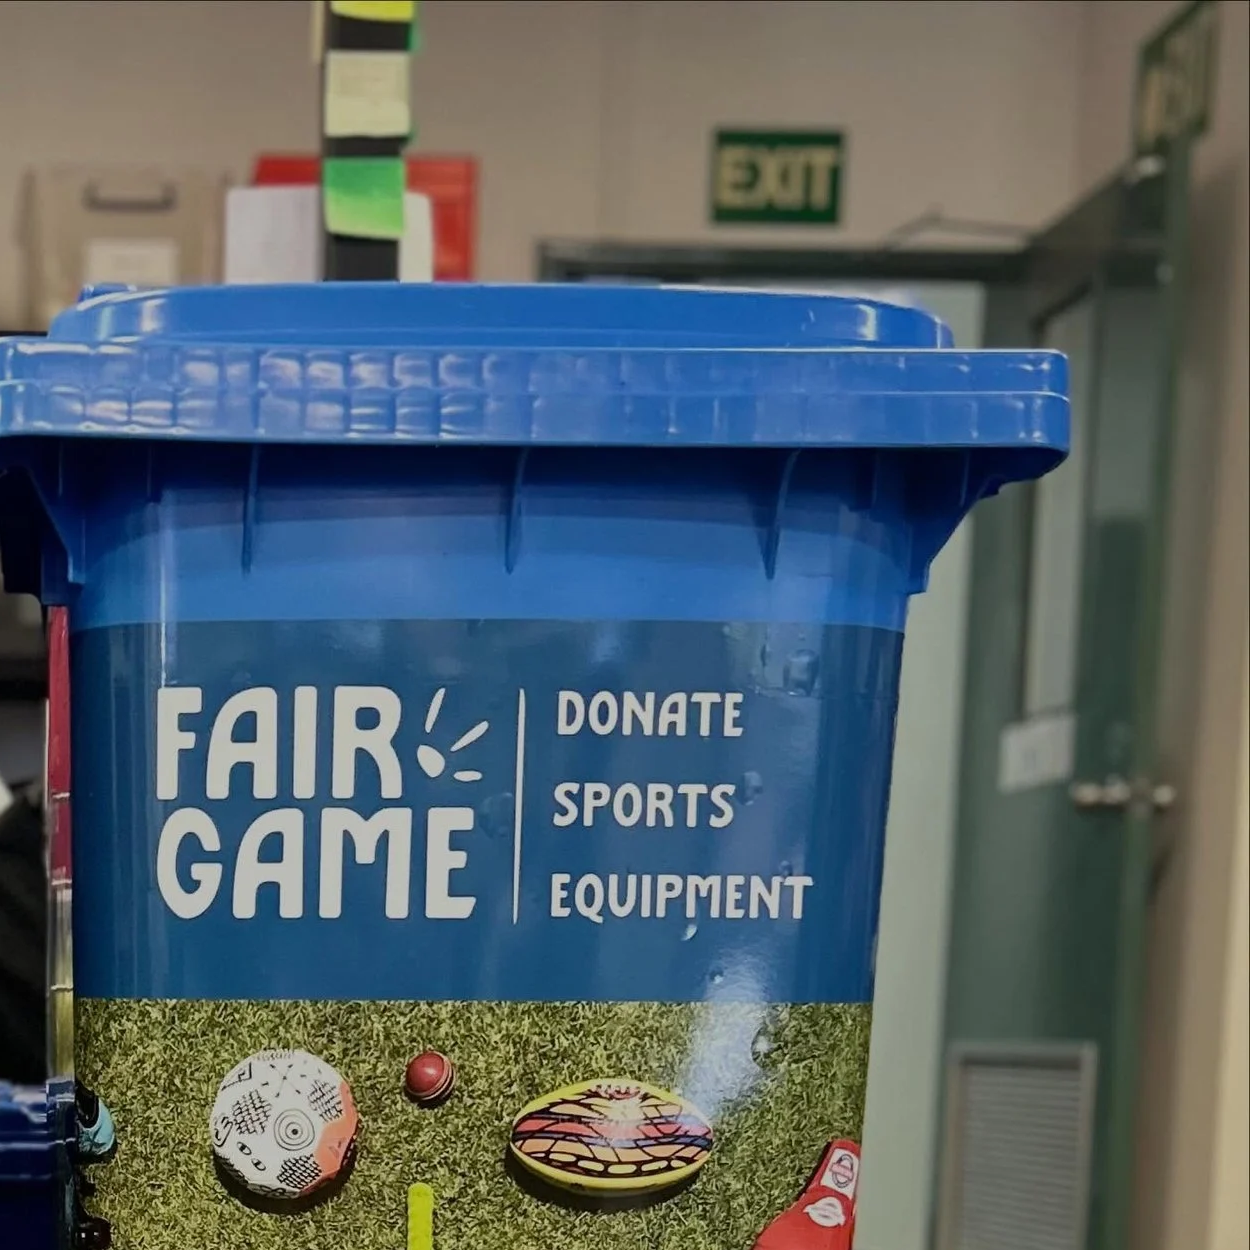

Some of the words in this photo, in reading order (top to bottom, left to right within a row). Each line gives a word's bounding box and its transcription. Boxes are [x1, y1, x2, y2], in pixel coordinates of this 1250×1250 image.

[718, 145, 836, 209] EXIT
[558, 691, 743, 736] DONATE
[157, 686, 401, 799] FAIR
[554, 783, 736, 827] SPORTS
[157, 808, 476, 919] GAME
[552, 874, 813, 922] EQUIPMENT
